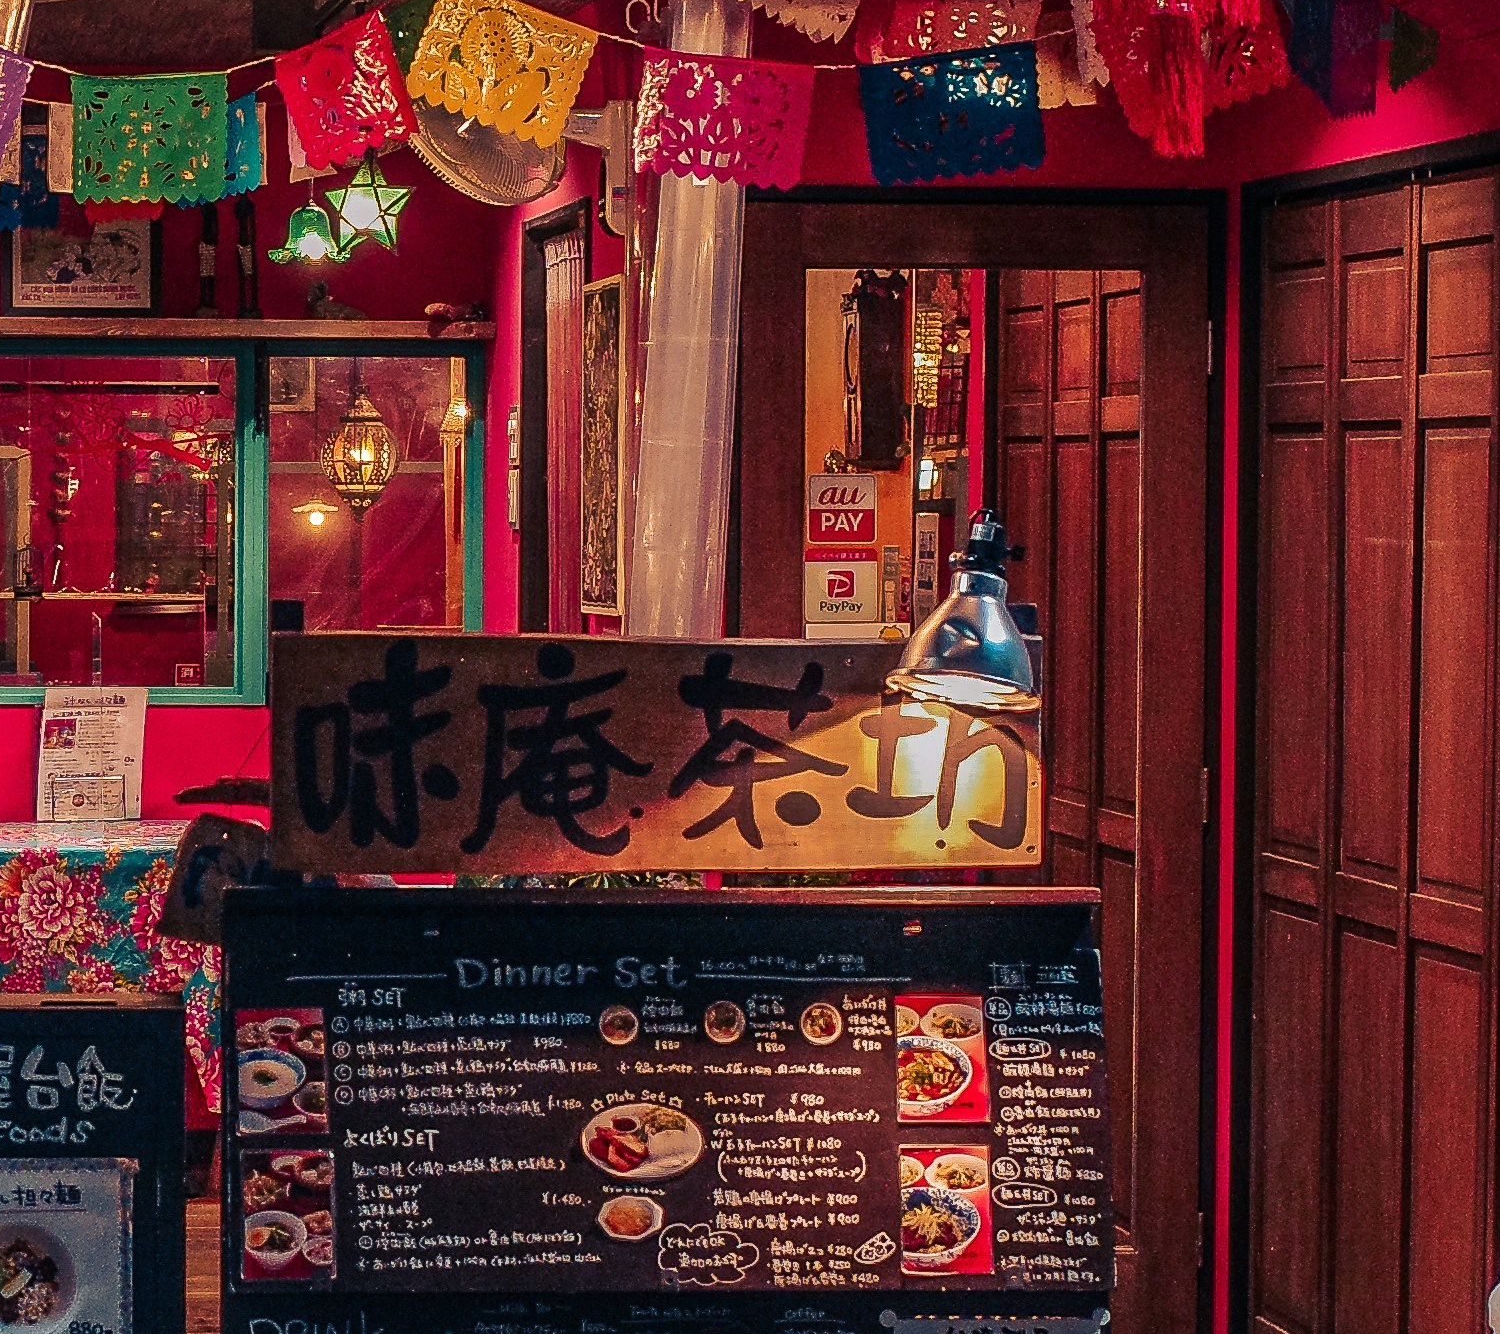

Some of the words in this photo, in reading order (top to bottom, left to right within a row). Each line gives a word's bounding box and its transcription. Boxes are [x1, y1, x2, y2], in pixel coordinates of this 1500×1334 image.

[818, 485, 867, 506] au
[820, 512, 864, 532] PAY
[819, 600, 863, 613] PayPay
[293, 637, 1028, 857] 味庵茶坊
[454, 956, 600, 989] Dinner
[613, 955, 688, 988] Set
[371, 986, 407, 1008] SET
